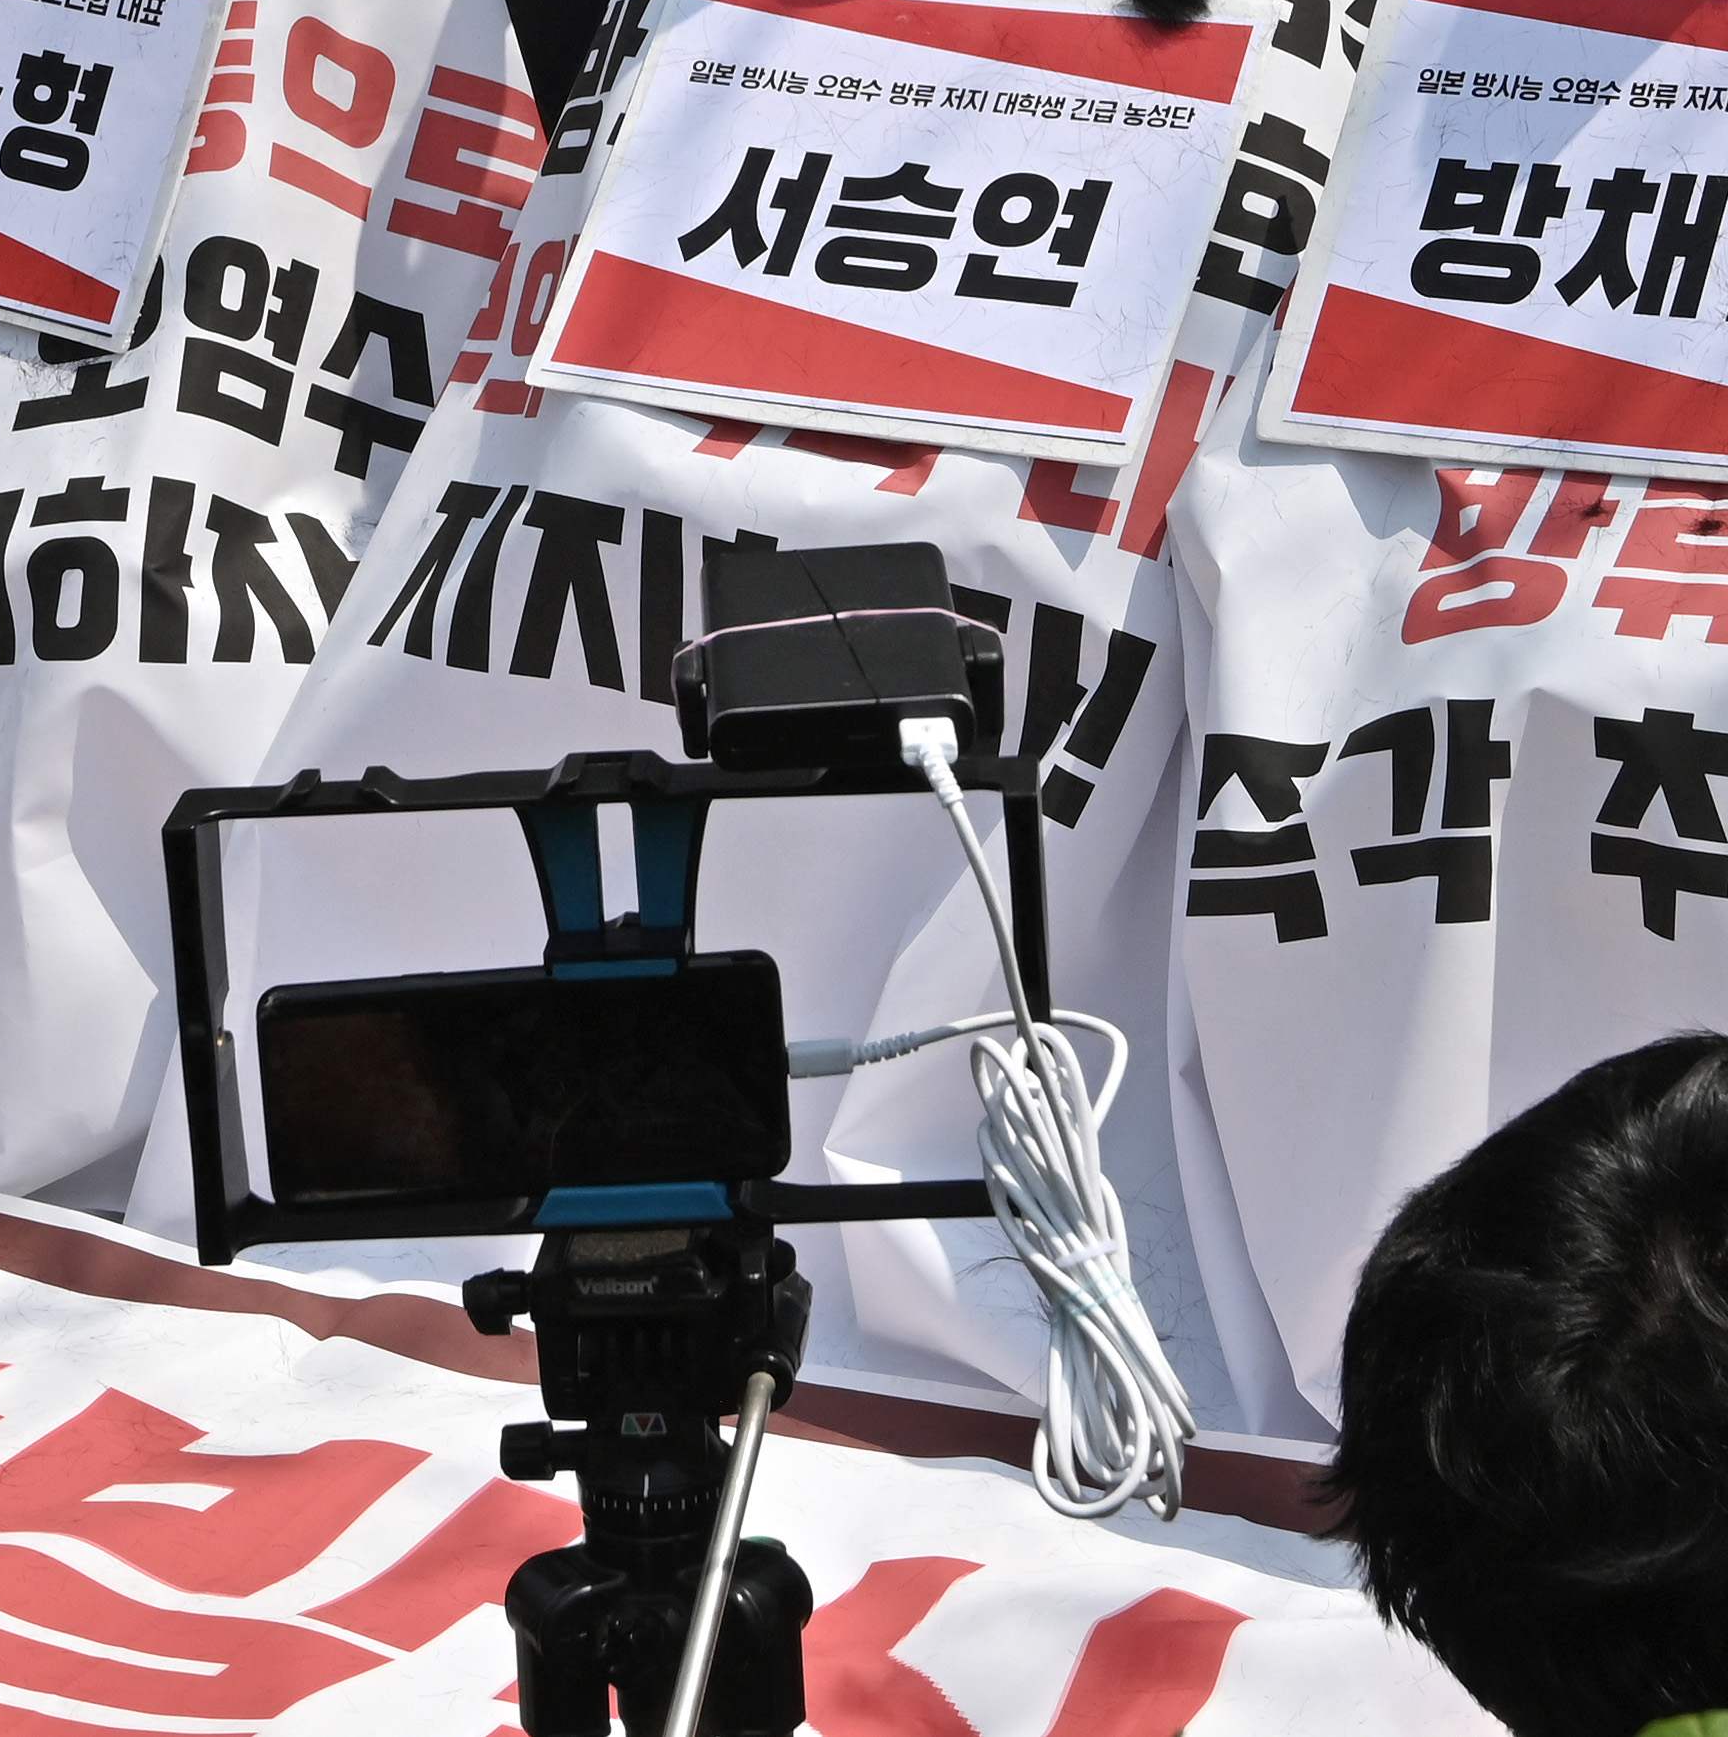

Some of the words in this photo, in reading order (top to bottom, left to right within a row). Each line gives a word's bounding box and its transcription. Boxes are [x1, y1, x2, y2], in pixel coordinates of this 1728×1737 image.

[688, 59, 737, 86] 일본
[741, 65, 809, 96] 방사능
[814, 74, 882, 103] 오염수
[888, 81, 936, 109] 방류
[939, 86, 990, 114] 저지
[992, 90, 1067, 121] 대학생
[1069, 97, 1118, 126] 긴급
[1122, 103, 1196, 131] 농성단
[1416, 67, 1466, 96] 일본
[1470, 71, 1543, 102] 방사능
[1548, 76, 1622, 107] 오염수
[1627, 81, 1679, 110] 방류
[678, 146, 1112, 308] 서승연
[1185, 698, 1512, 944] 즉각
[576, 1277, 656, 1295] Velbon
